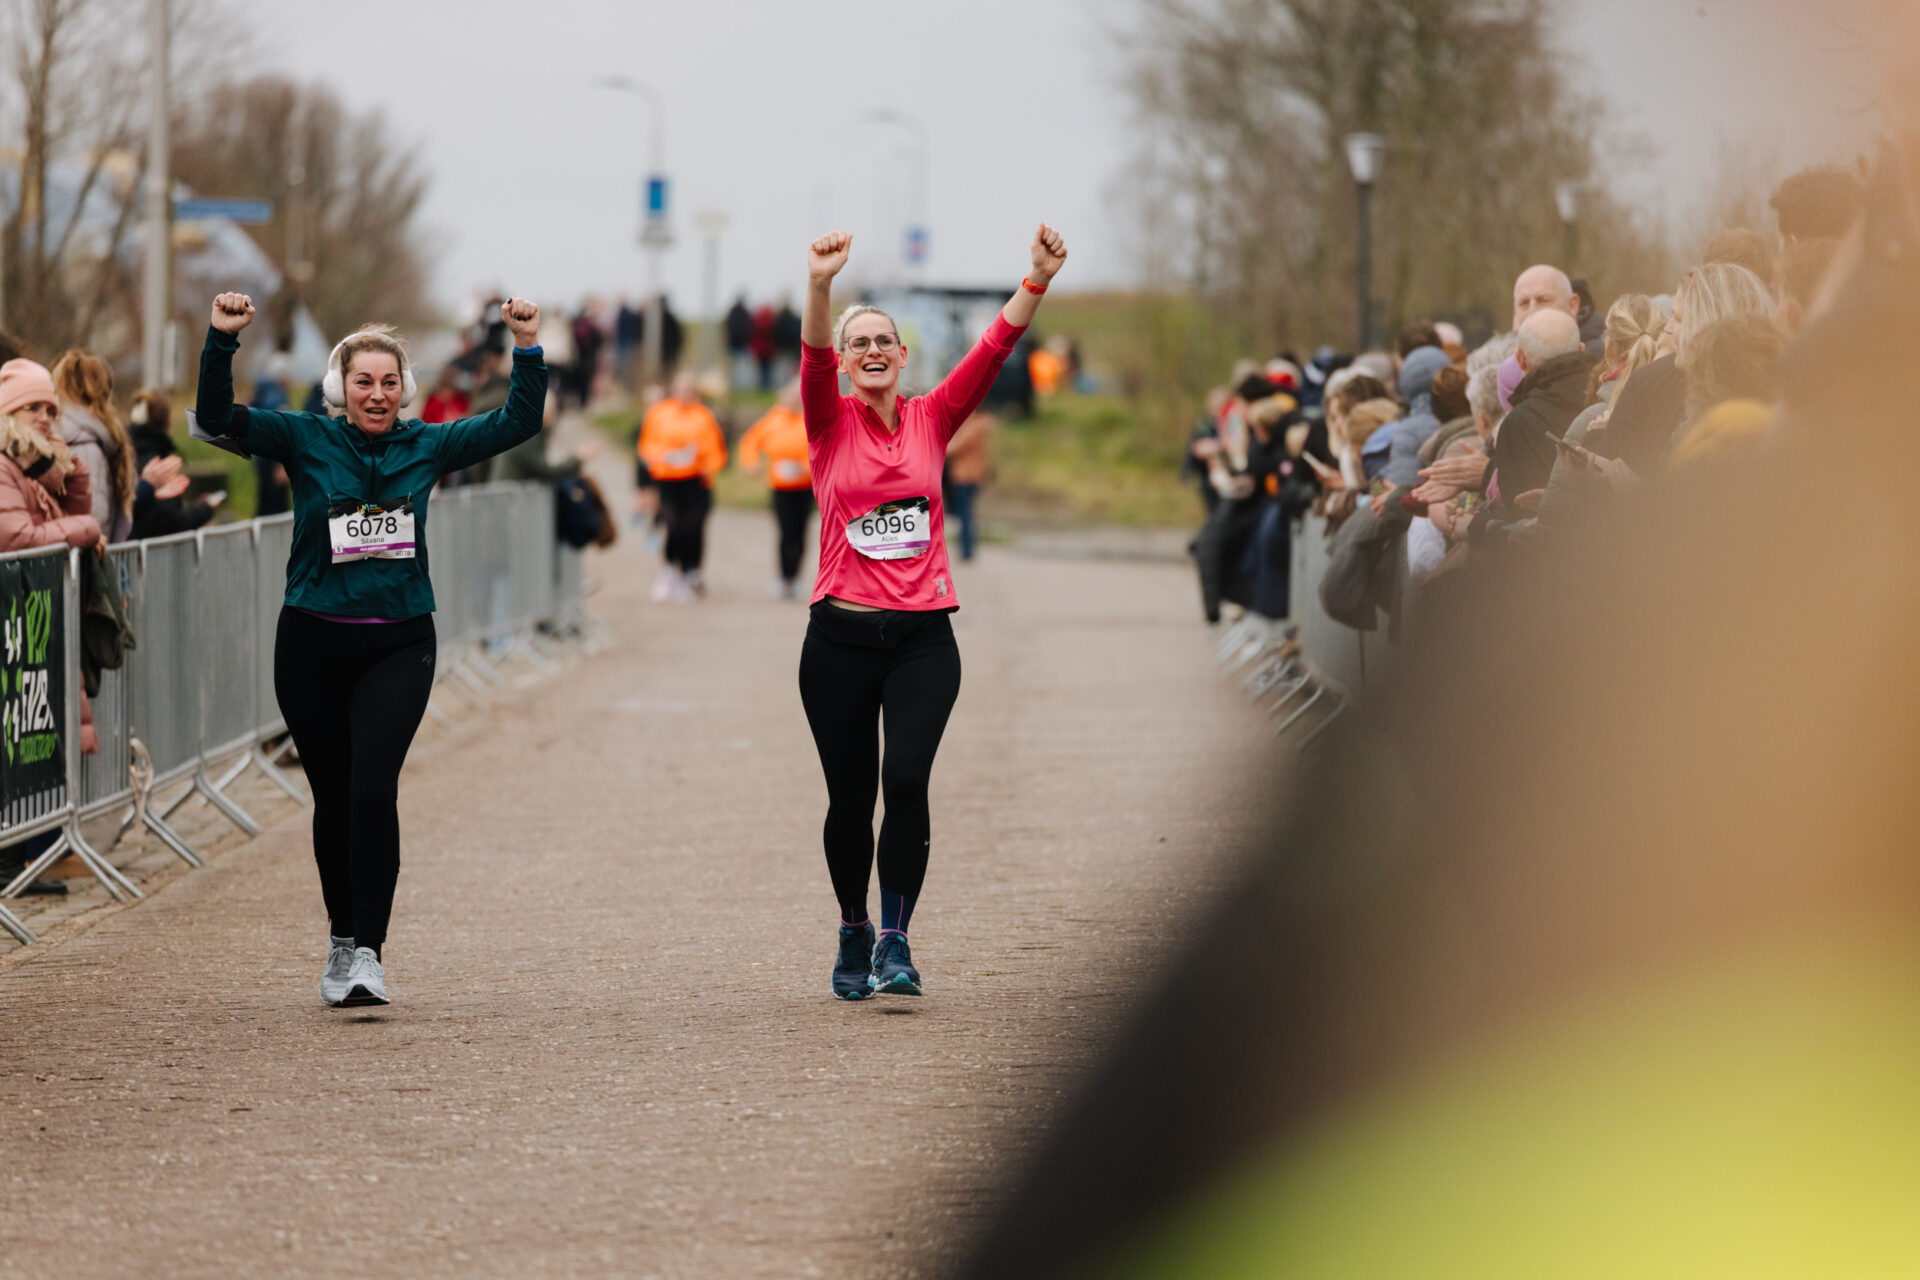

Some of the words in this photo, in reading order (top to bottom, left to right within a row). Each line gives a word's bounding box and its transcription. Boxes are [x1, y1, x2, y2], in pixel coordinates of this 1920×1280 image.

[346, 516, 398, 538] 6078
[861, 514, 915, 537] 6096
[361, 537, 385, 545] Silvana
[881, 535, 898, 543] Alies
